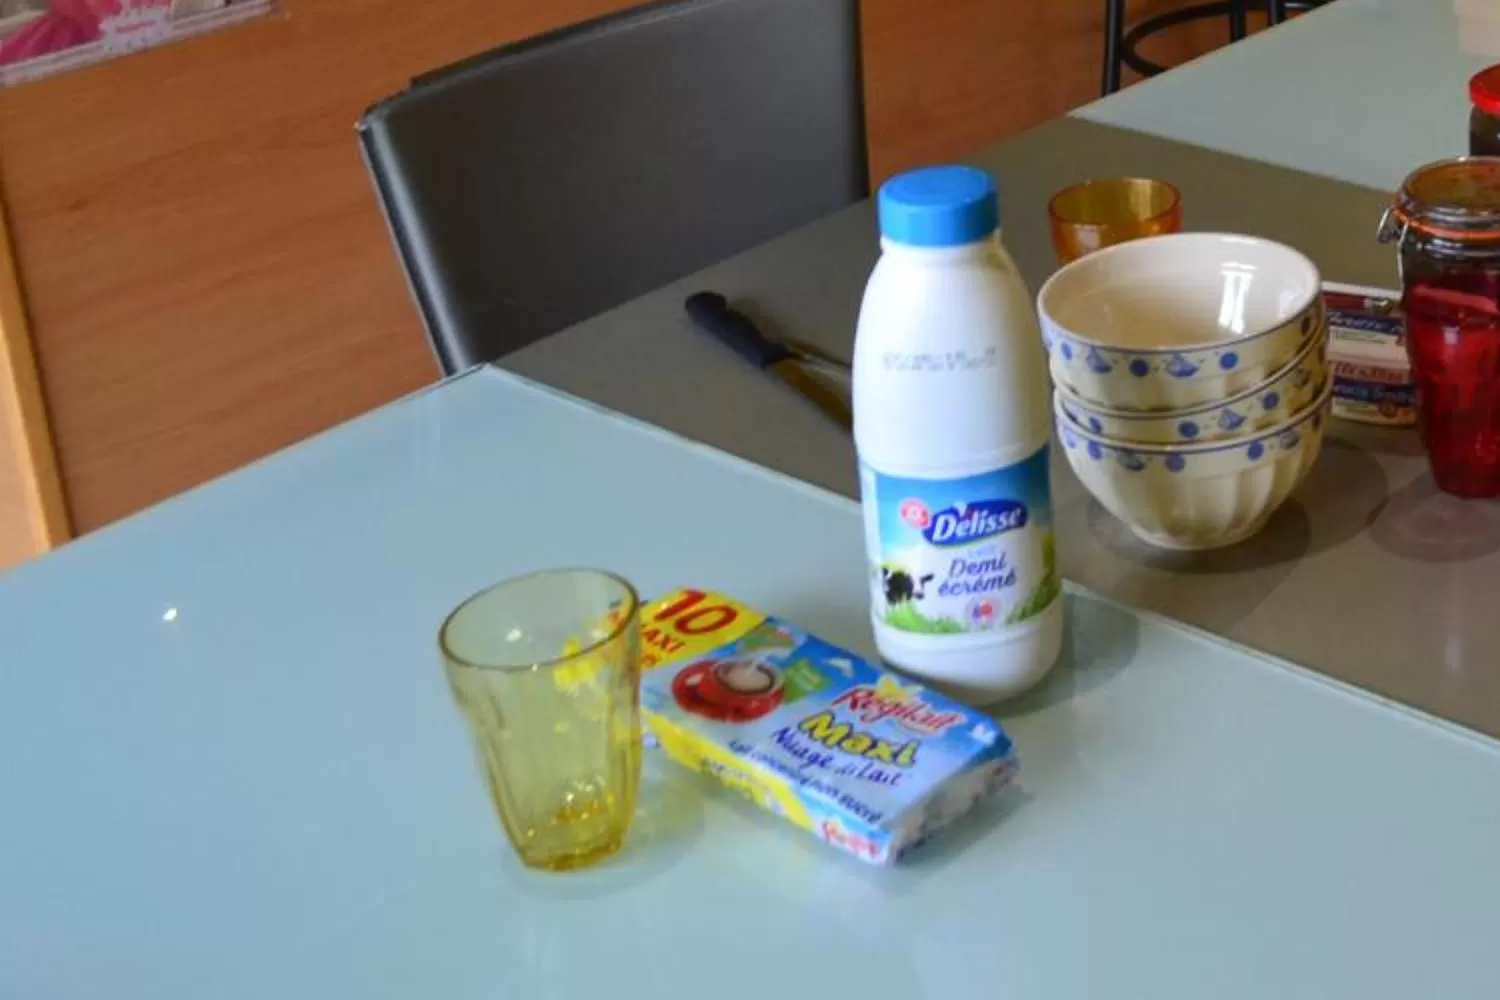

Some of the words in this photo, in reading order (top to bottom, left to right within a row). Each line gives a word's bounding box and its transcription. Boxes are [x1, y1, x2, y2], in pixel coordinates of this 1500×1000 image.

[931, 505, 1022, 542] Delisse
[938, 566, 1017, 597] écrémé
[949, 551, 1006, 578] Demi
[654, 589, 738, 635] 10
[771, 726, 834, 770] Nuage
[799, 709, 921, 768] Maxi
